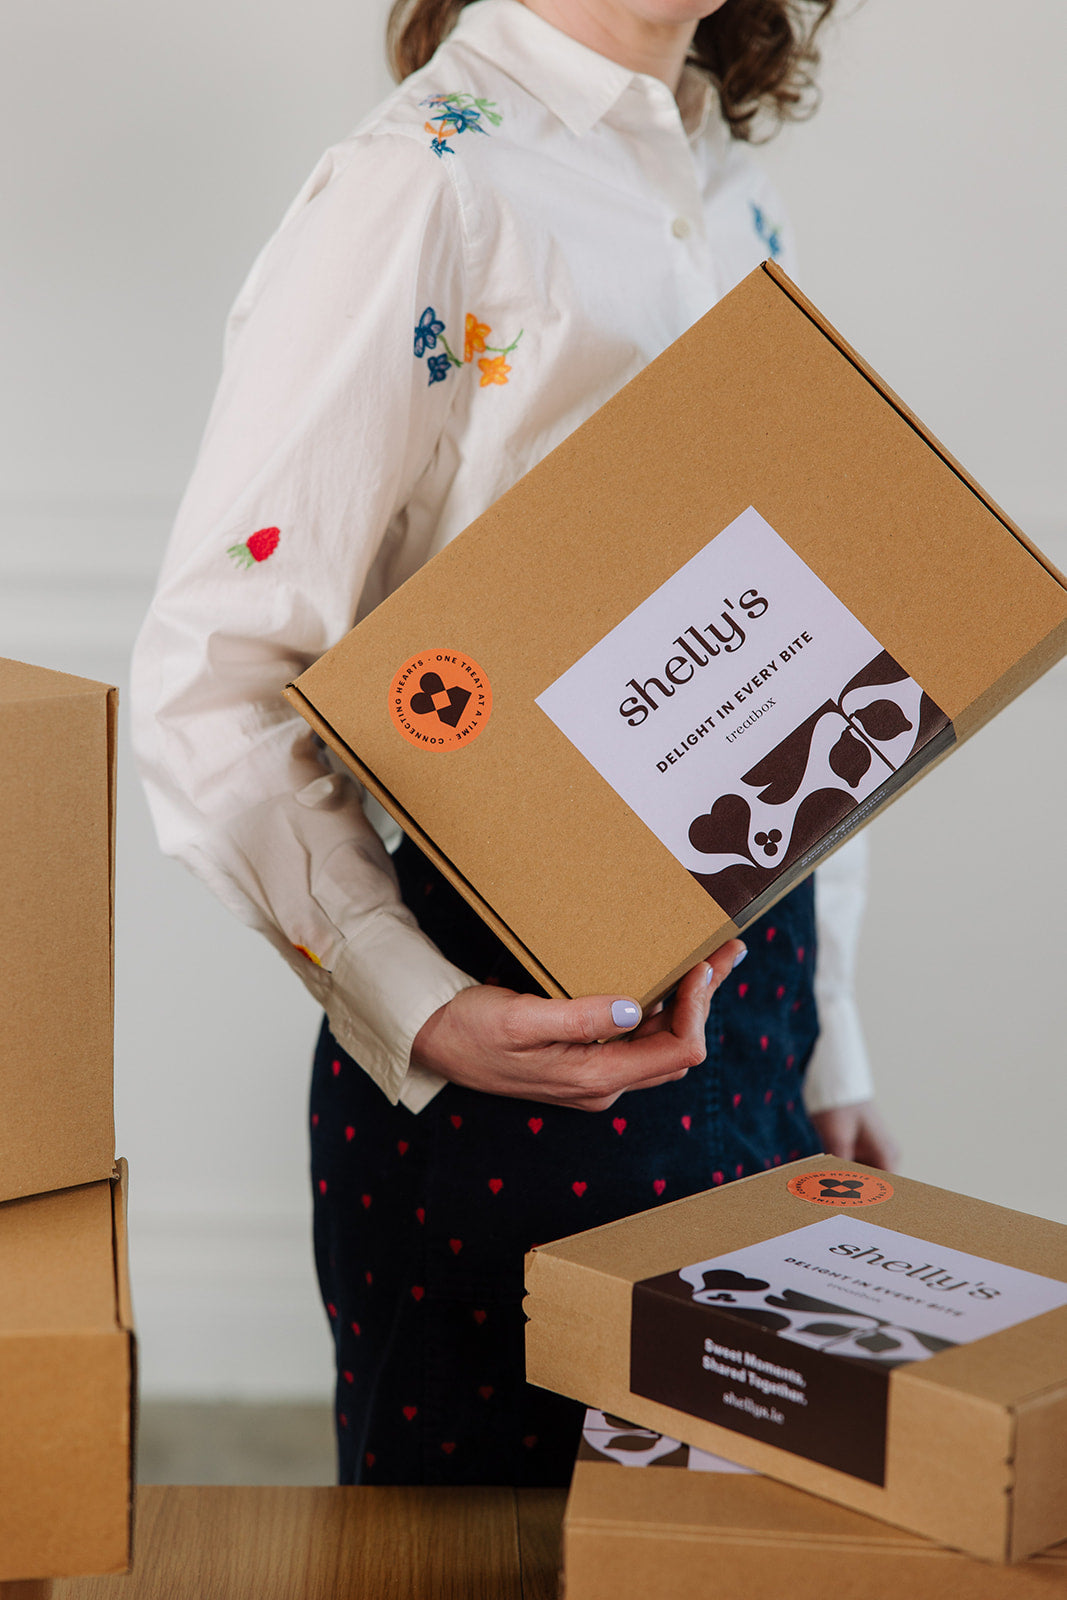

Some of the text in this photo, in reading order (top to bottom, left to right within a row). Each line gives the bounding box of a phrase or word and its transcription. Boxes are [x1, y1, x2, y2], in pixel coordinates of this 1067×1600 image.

[436, 654, 457, 664] ONE
[619, 589, 769, 726] shelly's
[396, 660, 424, 693] HEARTS
[460, 661, 483, 689] TREAT
[478, 694, 485, 706] AT
[656, 630, 813, 773] DELIGHT IN EVERY BITE
[395, 698, 444, 744] CONNECTING
[455, 720, 478, 740] TIME
[726, 697, 776, 743] treatbox
[829, 1243, 1001, 1300] shelly's
[704, 1338, 743, 1364] Sweet
[702, 1355, 747, 1382] Shared
